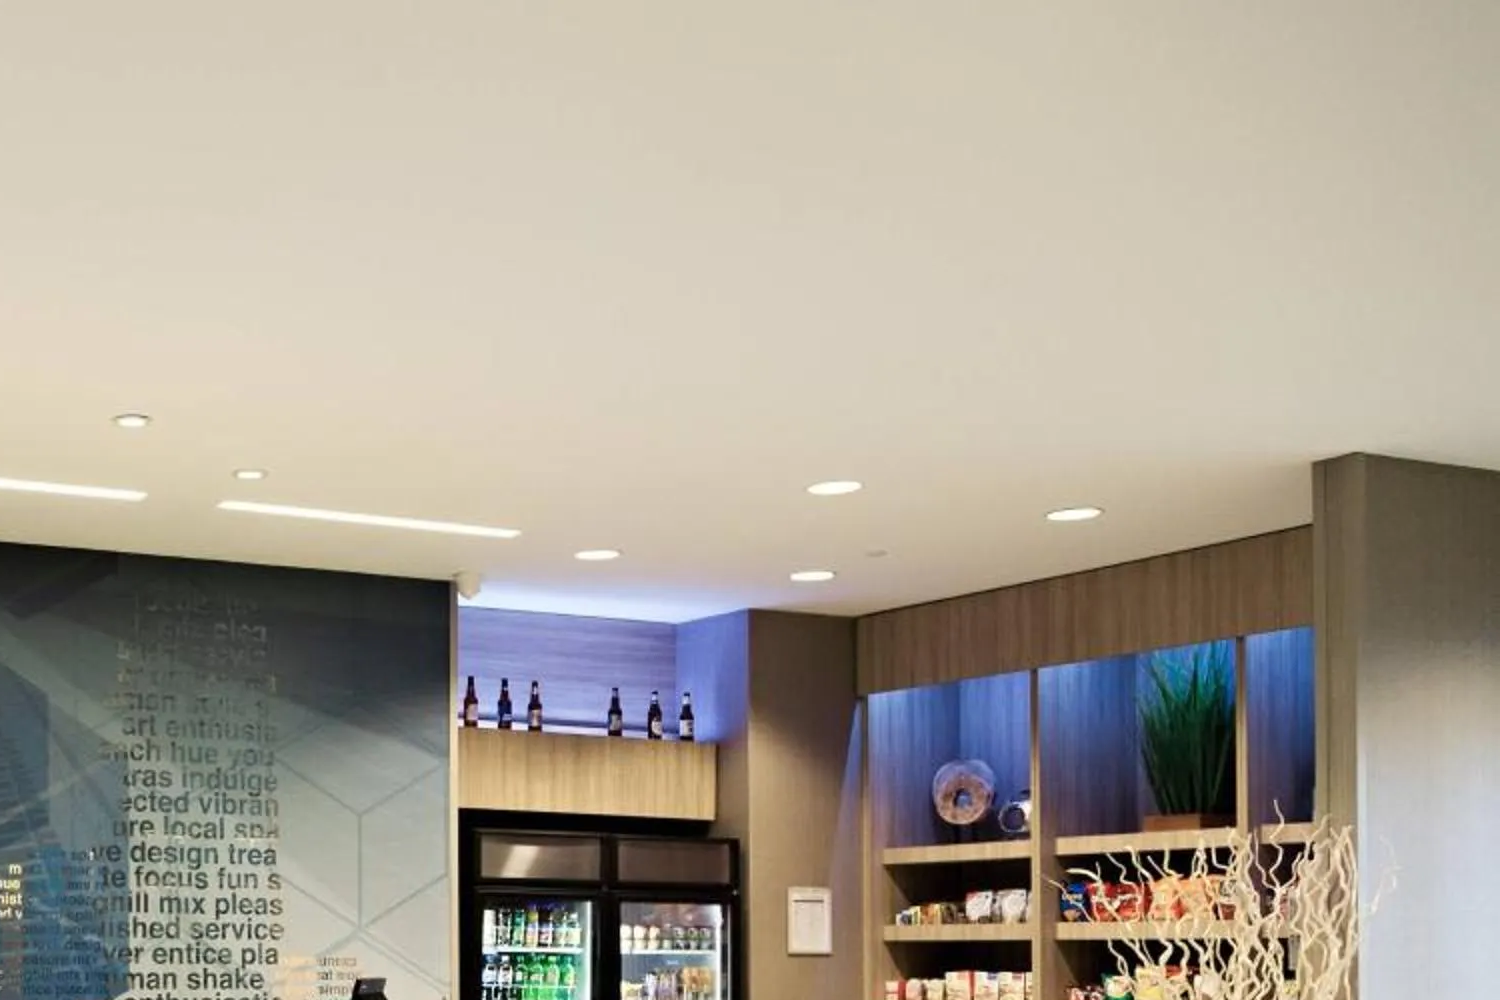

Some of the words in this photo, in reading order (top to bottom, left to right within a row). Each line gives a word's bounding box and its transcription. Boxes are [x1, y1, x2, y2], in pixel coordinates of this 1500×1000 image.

[171, 740, 219, 764] hue
[228, 747, 276, 771] you
[182, 766, 278, 797] indulge
[198, 792, 280, 818] vibran
[163, 816, 226, 840] local
[130, 842, 219, 870] design
[228, 844, 278, 866] trea
[134, 868, 209, 891] focus
[217, 868, 259, 892] fun
[267, 873, 283, 892] s
[159, 895, 206, 915] mix
[215, 893, 285, 920] pleas
[189, 917, 286, 942] service
[151, 942, 233, 967] entice
[241, 944, 280, 968] pla
[186, 968, 265, 991] shake
